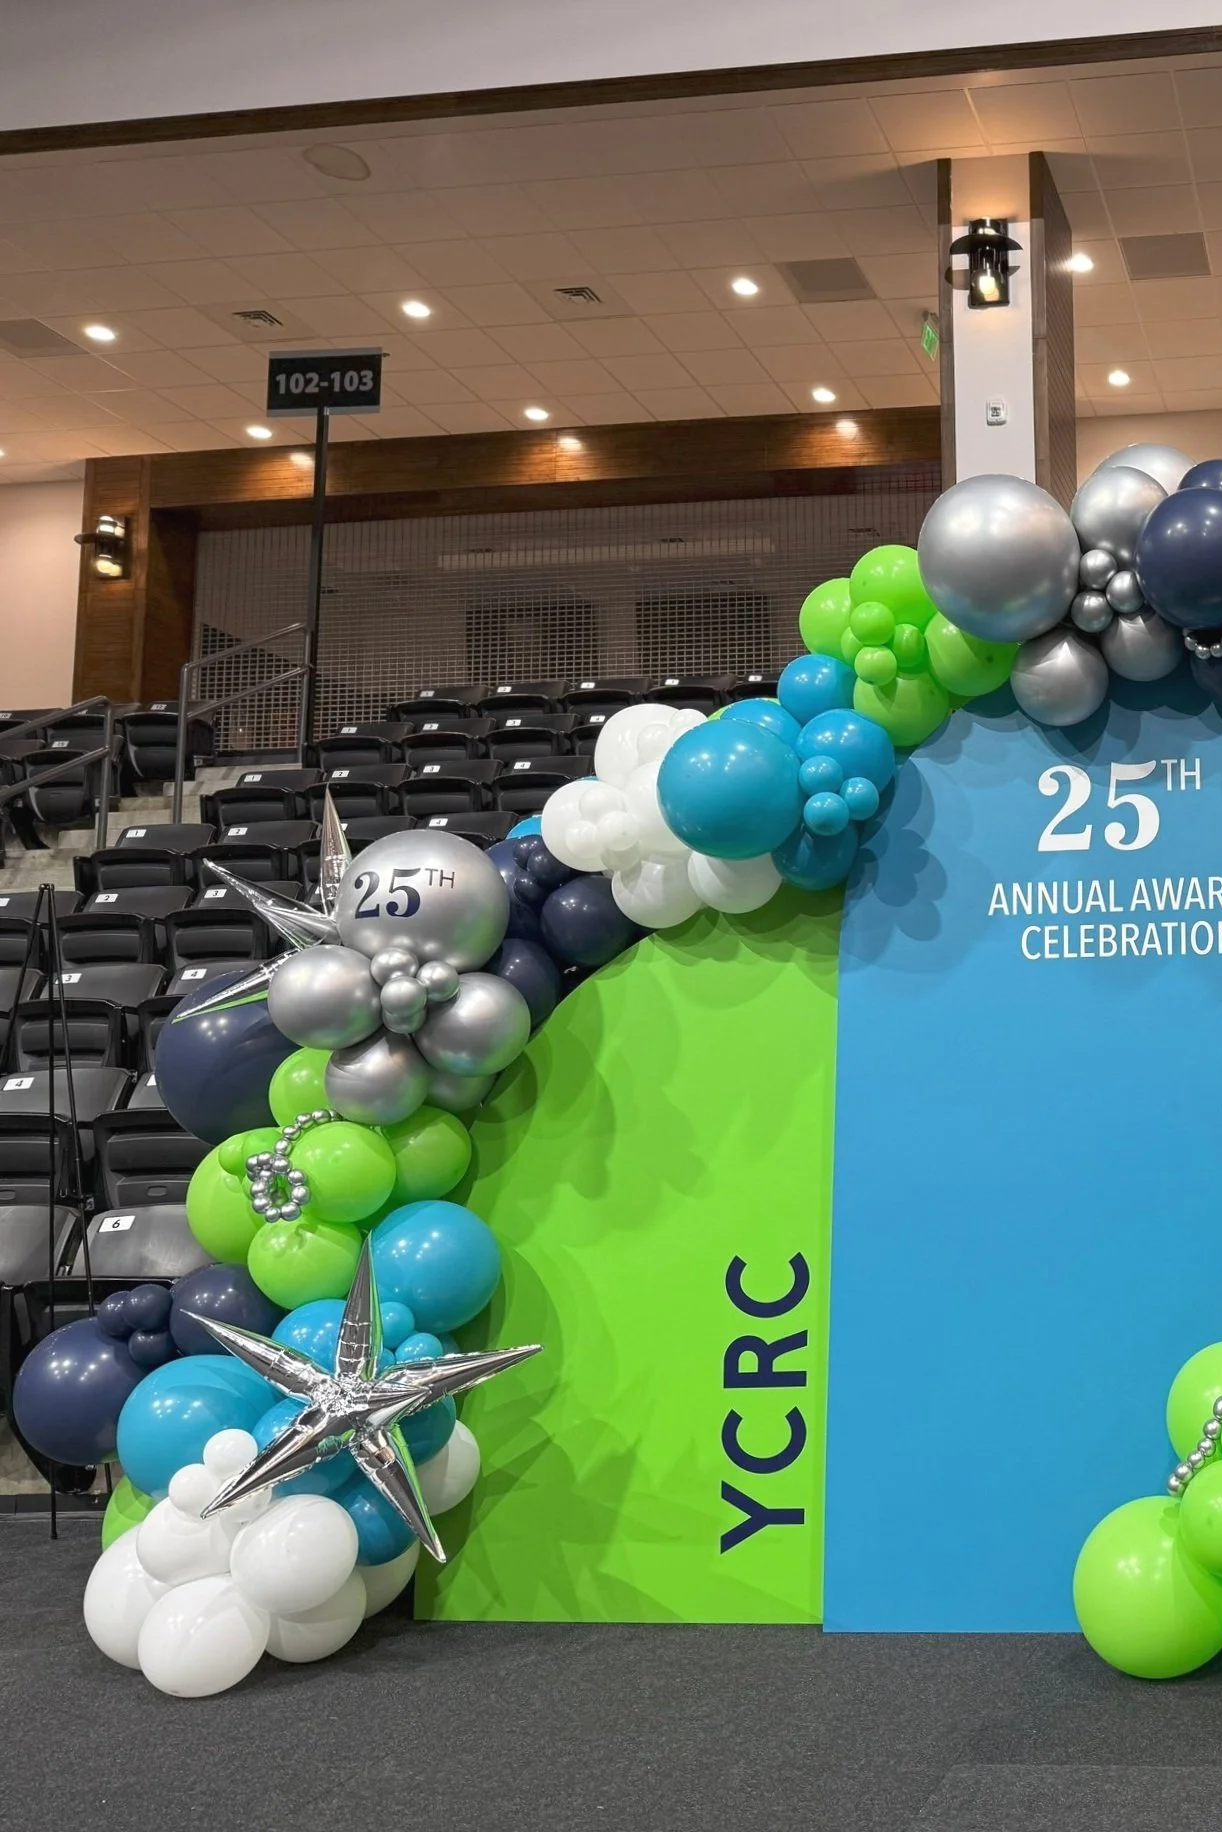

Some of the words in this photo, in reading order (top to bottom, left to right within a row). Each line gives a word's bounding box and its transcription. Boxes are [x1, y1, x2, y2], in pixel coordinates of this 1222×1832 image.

[275, 369, 374, 395] 102-103
[1037, 758, 1201, 852] 25TH
[354, 867, 455, 919] 25TH
[988, 879, 1124, 916] ANNUAL
[112, 1219, 121, 1229] 6
[720, 1251, 811, 1555] YCRC
